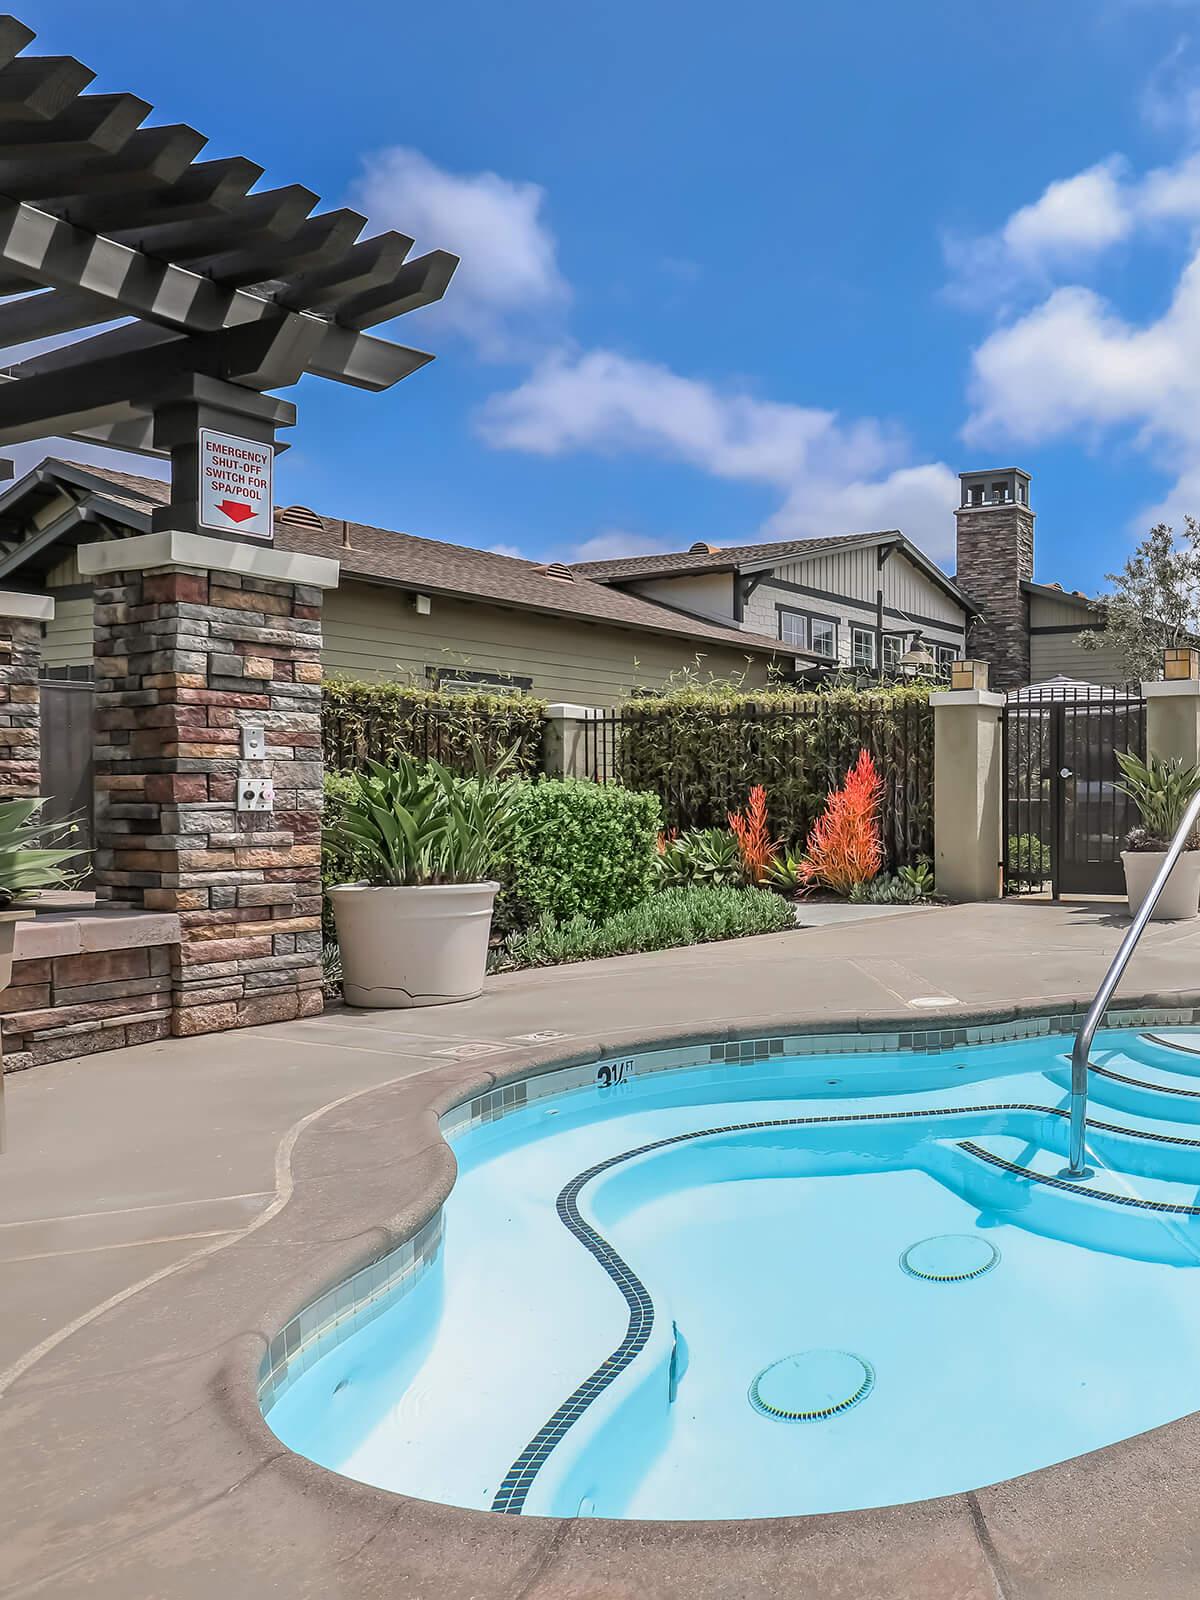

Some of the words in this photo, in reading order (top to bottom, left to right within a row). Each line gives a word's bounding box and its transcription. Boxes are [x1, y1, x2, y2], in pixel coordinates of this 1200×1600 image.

[206, 442, 267, 465] EMERGENCY
[212, 456, 262, 475] SHUT-OFF
[206, 467, 245, 484] SWITCH
[248, 476, 267, 489] FOR
[211, 481, 262, 501] SPA/POOL
[625, 1060, 634, 1071] FT
